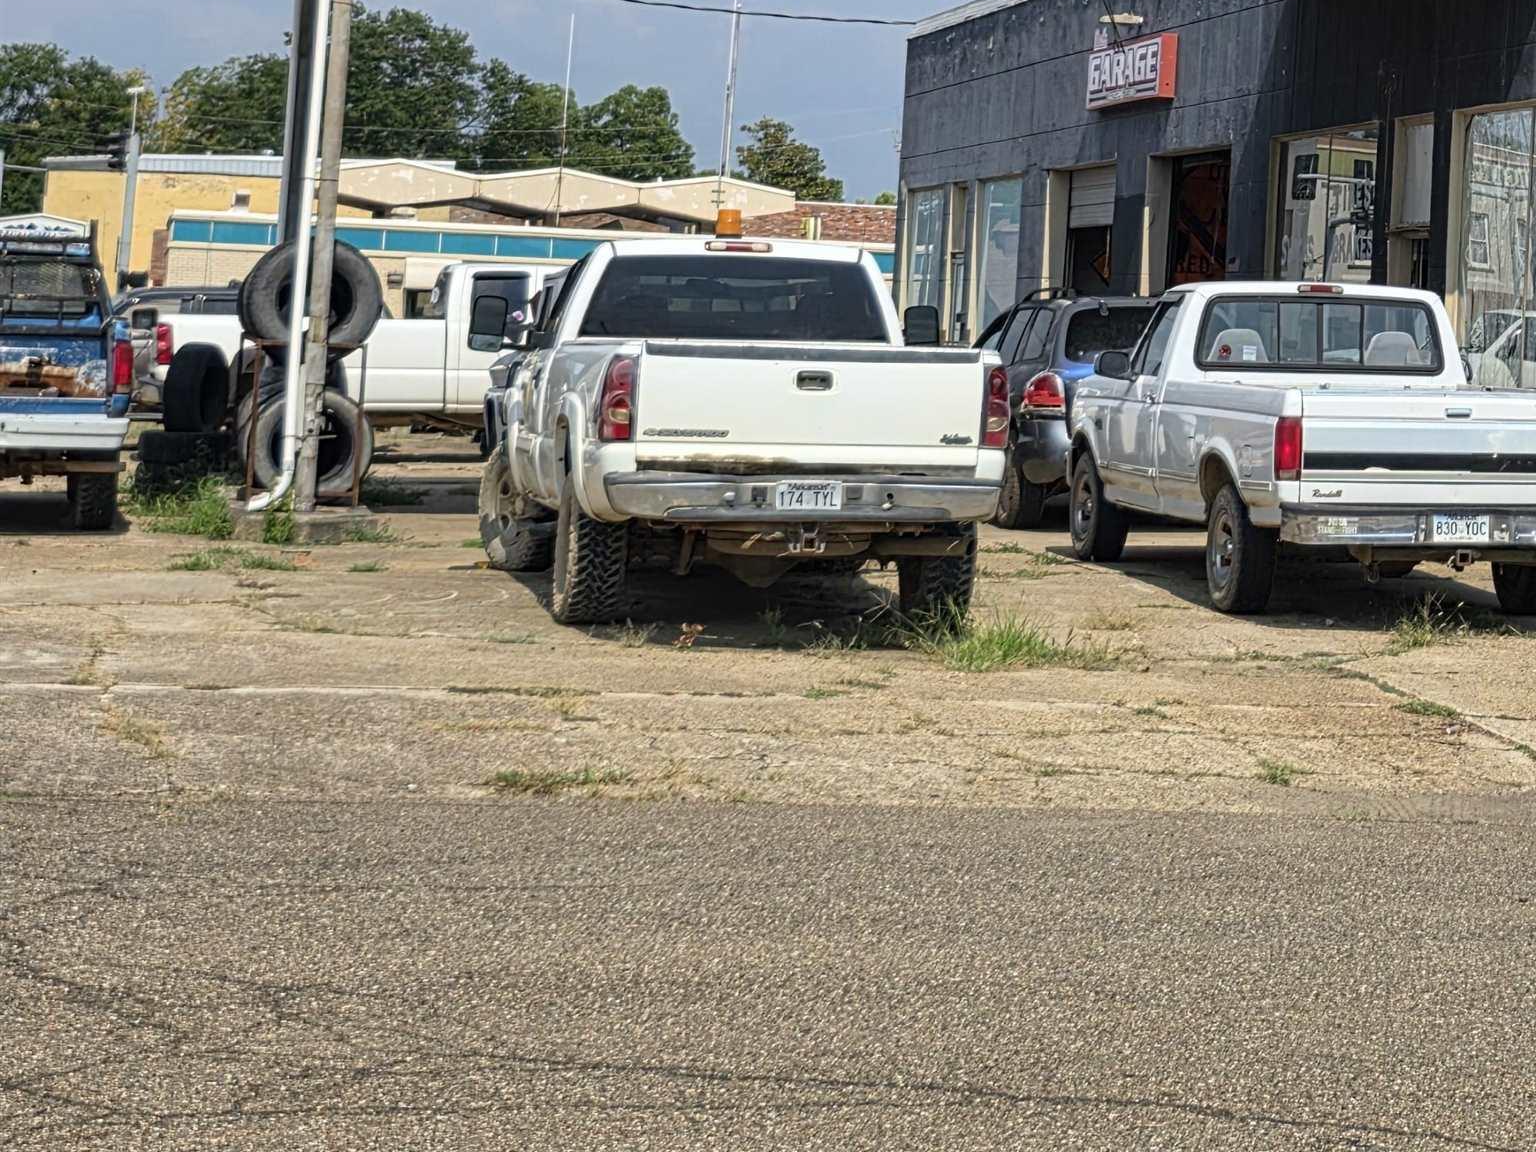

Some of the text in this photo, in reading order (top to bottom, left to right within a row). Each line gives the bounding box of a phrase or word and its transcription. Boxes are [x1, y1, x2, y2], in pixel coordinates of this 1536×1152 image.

[1089, 45, 1158, 91] GARAGE
[780, 490, 838, 508] 174 TYL
[1436, 521, 1458, 536] 830
